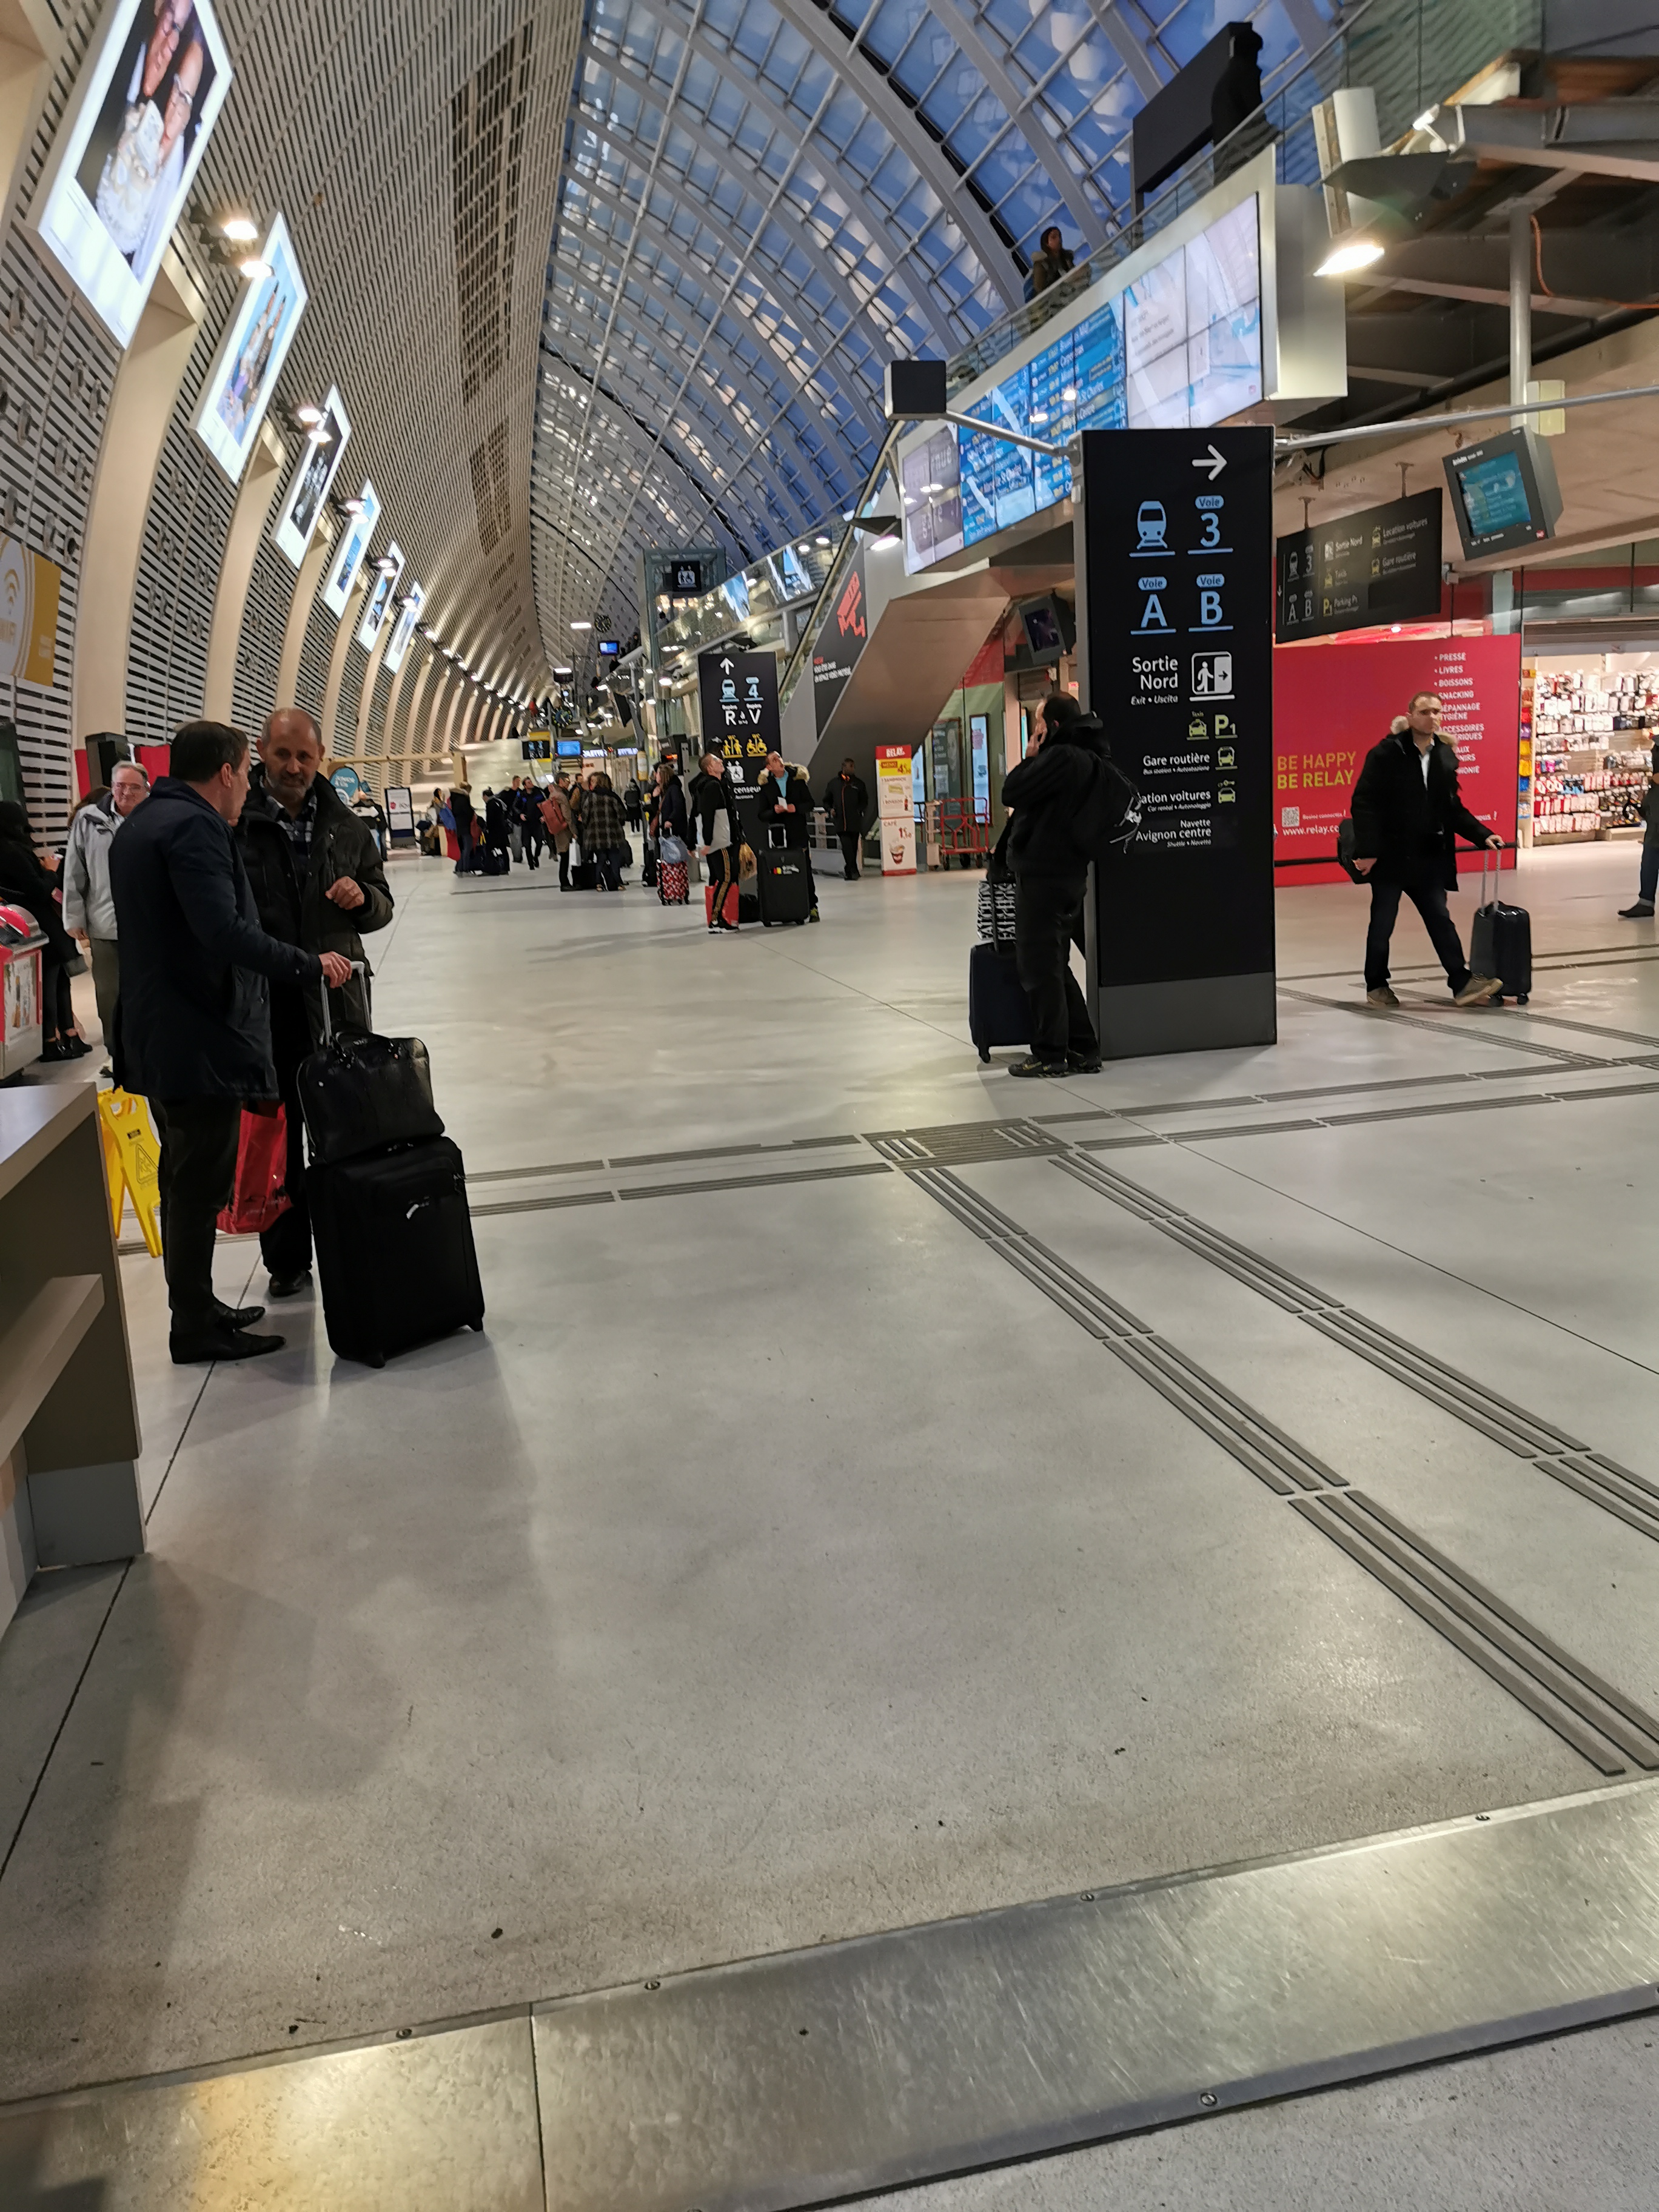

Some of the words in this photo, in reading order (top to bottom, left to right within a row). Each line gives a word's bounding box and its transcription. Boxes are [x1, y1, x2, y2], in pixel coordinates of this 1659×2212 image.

[1199, 498, 1220, 507] Voie
[1199, 512, 1221, 546] 3
[1350, 535, 1363, 546] Nord
[1305, 554, 1312, 573] 3
[1142, 579, 1164, 589] Voie
[1200, 576, 1221, 586] Voie
[1141, 594, 1167, 628] A
[1201, 591, 1223, 625] B
[1289, 603, 1296, 622] A
[1305, 598, 1312, 617] B
[1439, 652, 1466, 662] PRESSE
[1132, 655, 1178, 673] Sortie
[1439, 665, 1463, 675] LIVRES
[1140, 672, 1178, 691] Nord
[1438, 677, 1473, 687] BOISSONS
[748, 683, 759, 699] 4
[1438, 690, 1474, 700] SNACKING
[1154, 694, 1178, 703] Uscita
[725, 710, 737, 726] R
[748, 709, 761, 724] V
[1456, 732, 1483, 740] RIQUES
[1143, 756, 1167, 766] Gare
[1170, 752, 1210, 765] routière
[1277, 755, 1298, 771] BE
[1303, 751, 1356, 769] HAPPY
[1277, 773, 1298, 789] BE
[1303, 769, 1354, 788] RELAY
[1141, 792, 1168, 804] ation
[1170, 791, 1211, 802] voitures
[1180, 819, 1211, 828] Navette
[1282, 824, 1339, 836] www.relay.co
[1136, 830, 1177, 843] Avignon
[1179, 828, 1212, 839] centre
